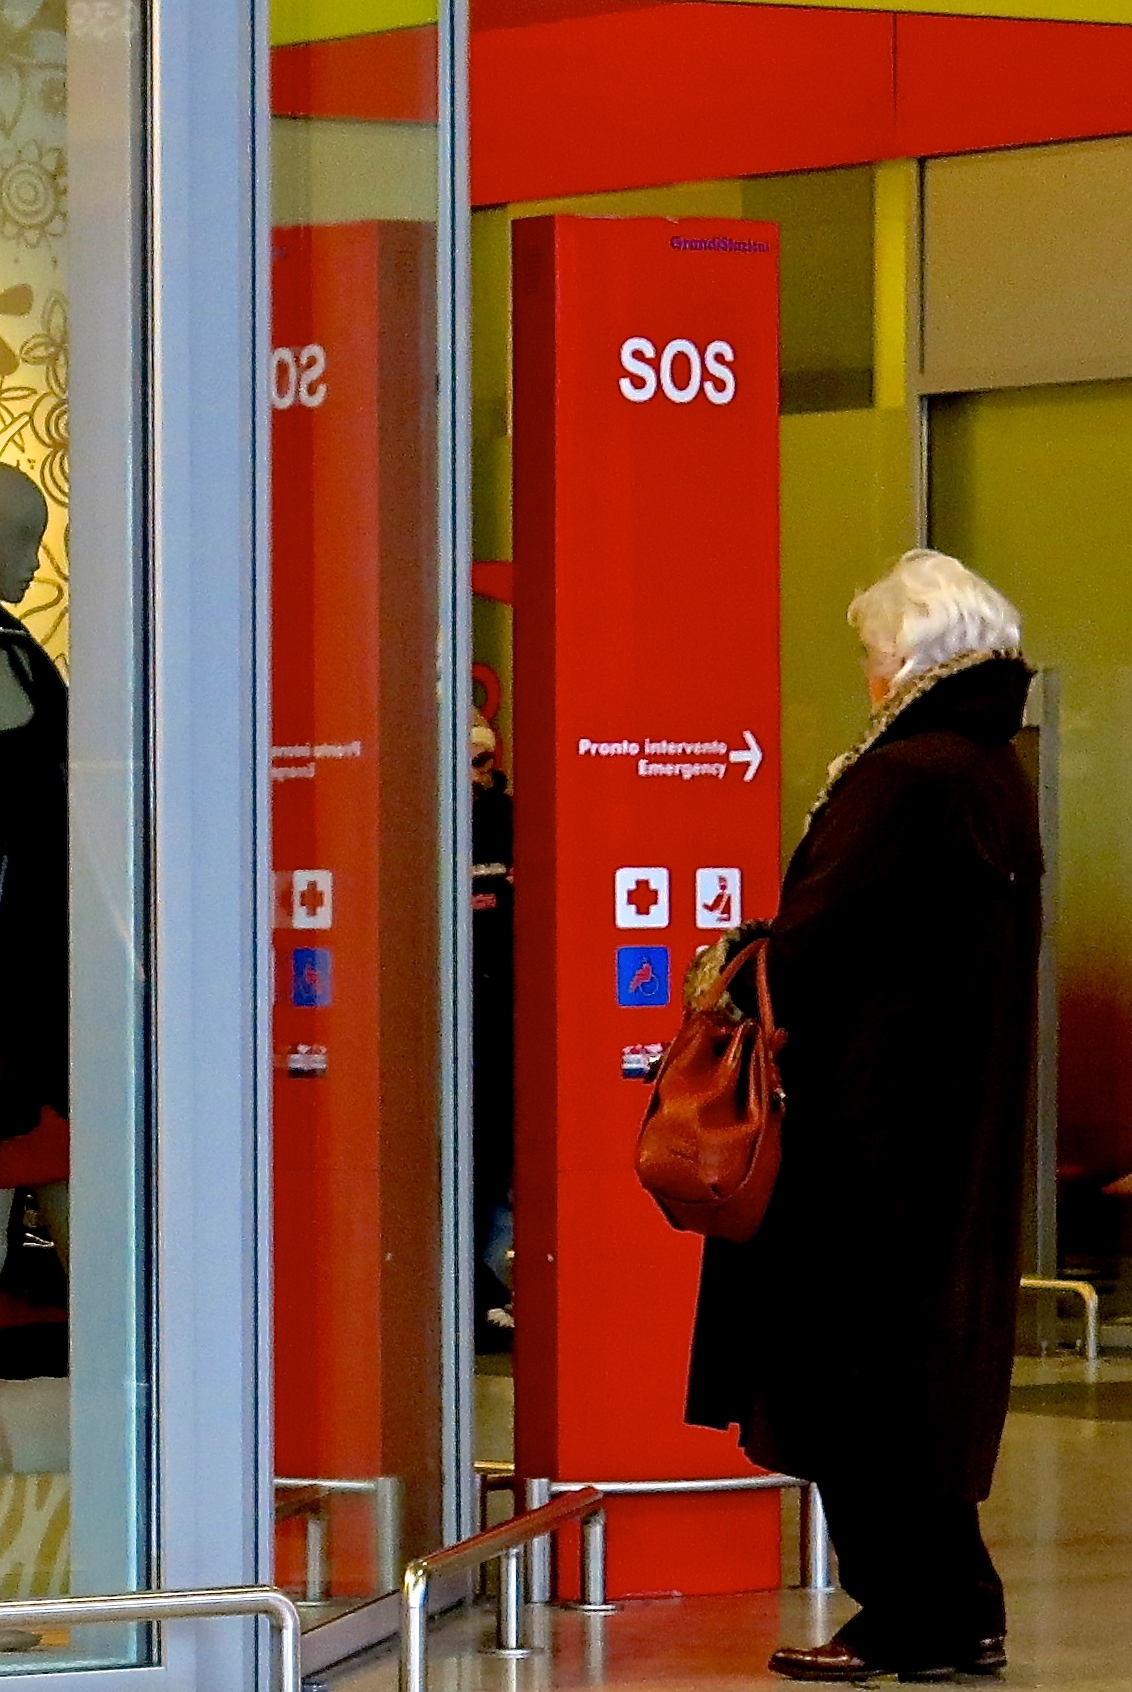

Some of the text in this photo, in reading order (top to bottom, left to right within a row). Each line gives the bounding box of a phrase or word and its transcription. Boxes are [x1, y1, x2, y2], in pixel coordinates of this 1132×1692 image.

[619, 337, 736, 405] SOS
[578, 738, 728, 755] Pronto intervento
[637, 758, 727, 780] Emergency
